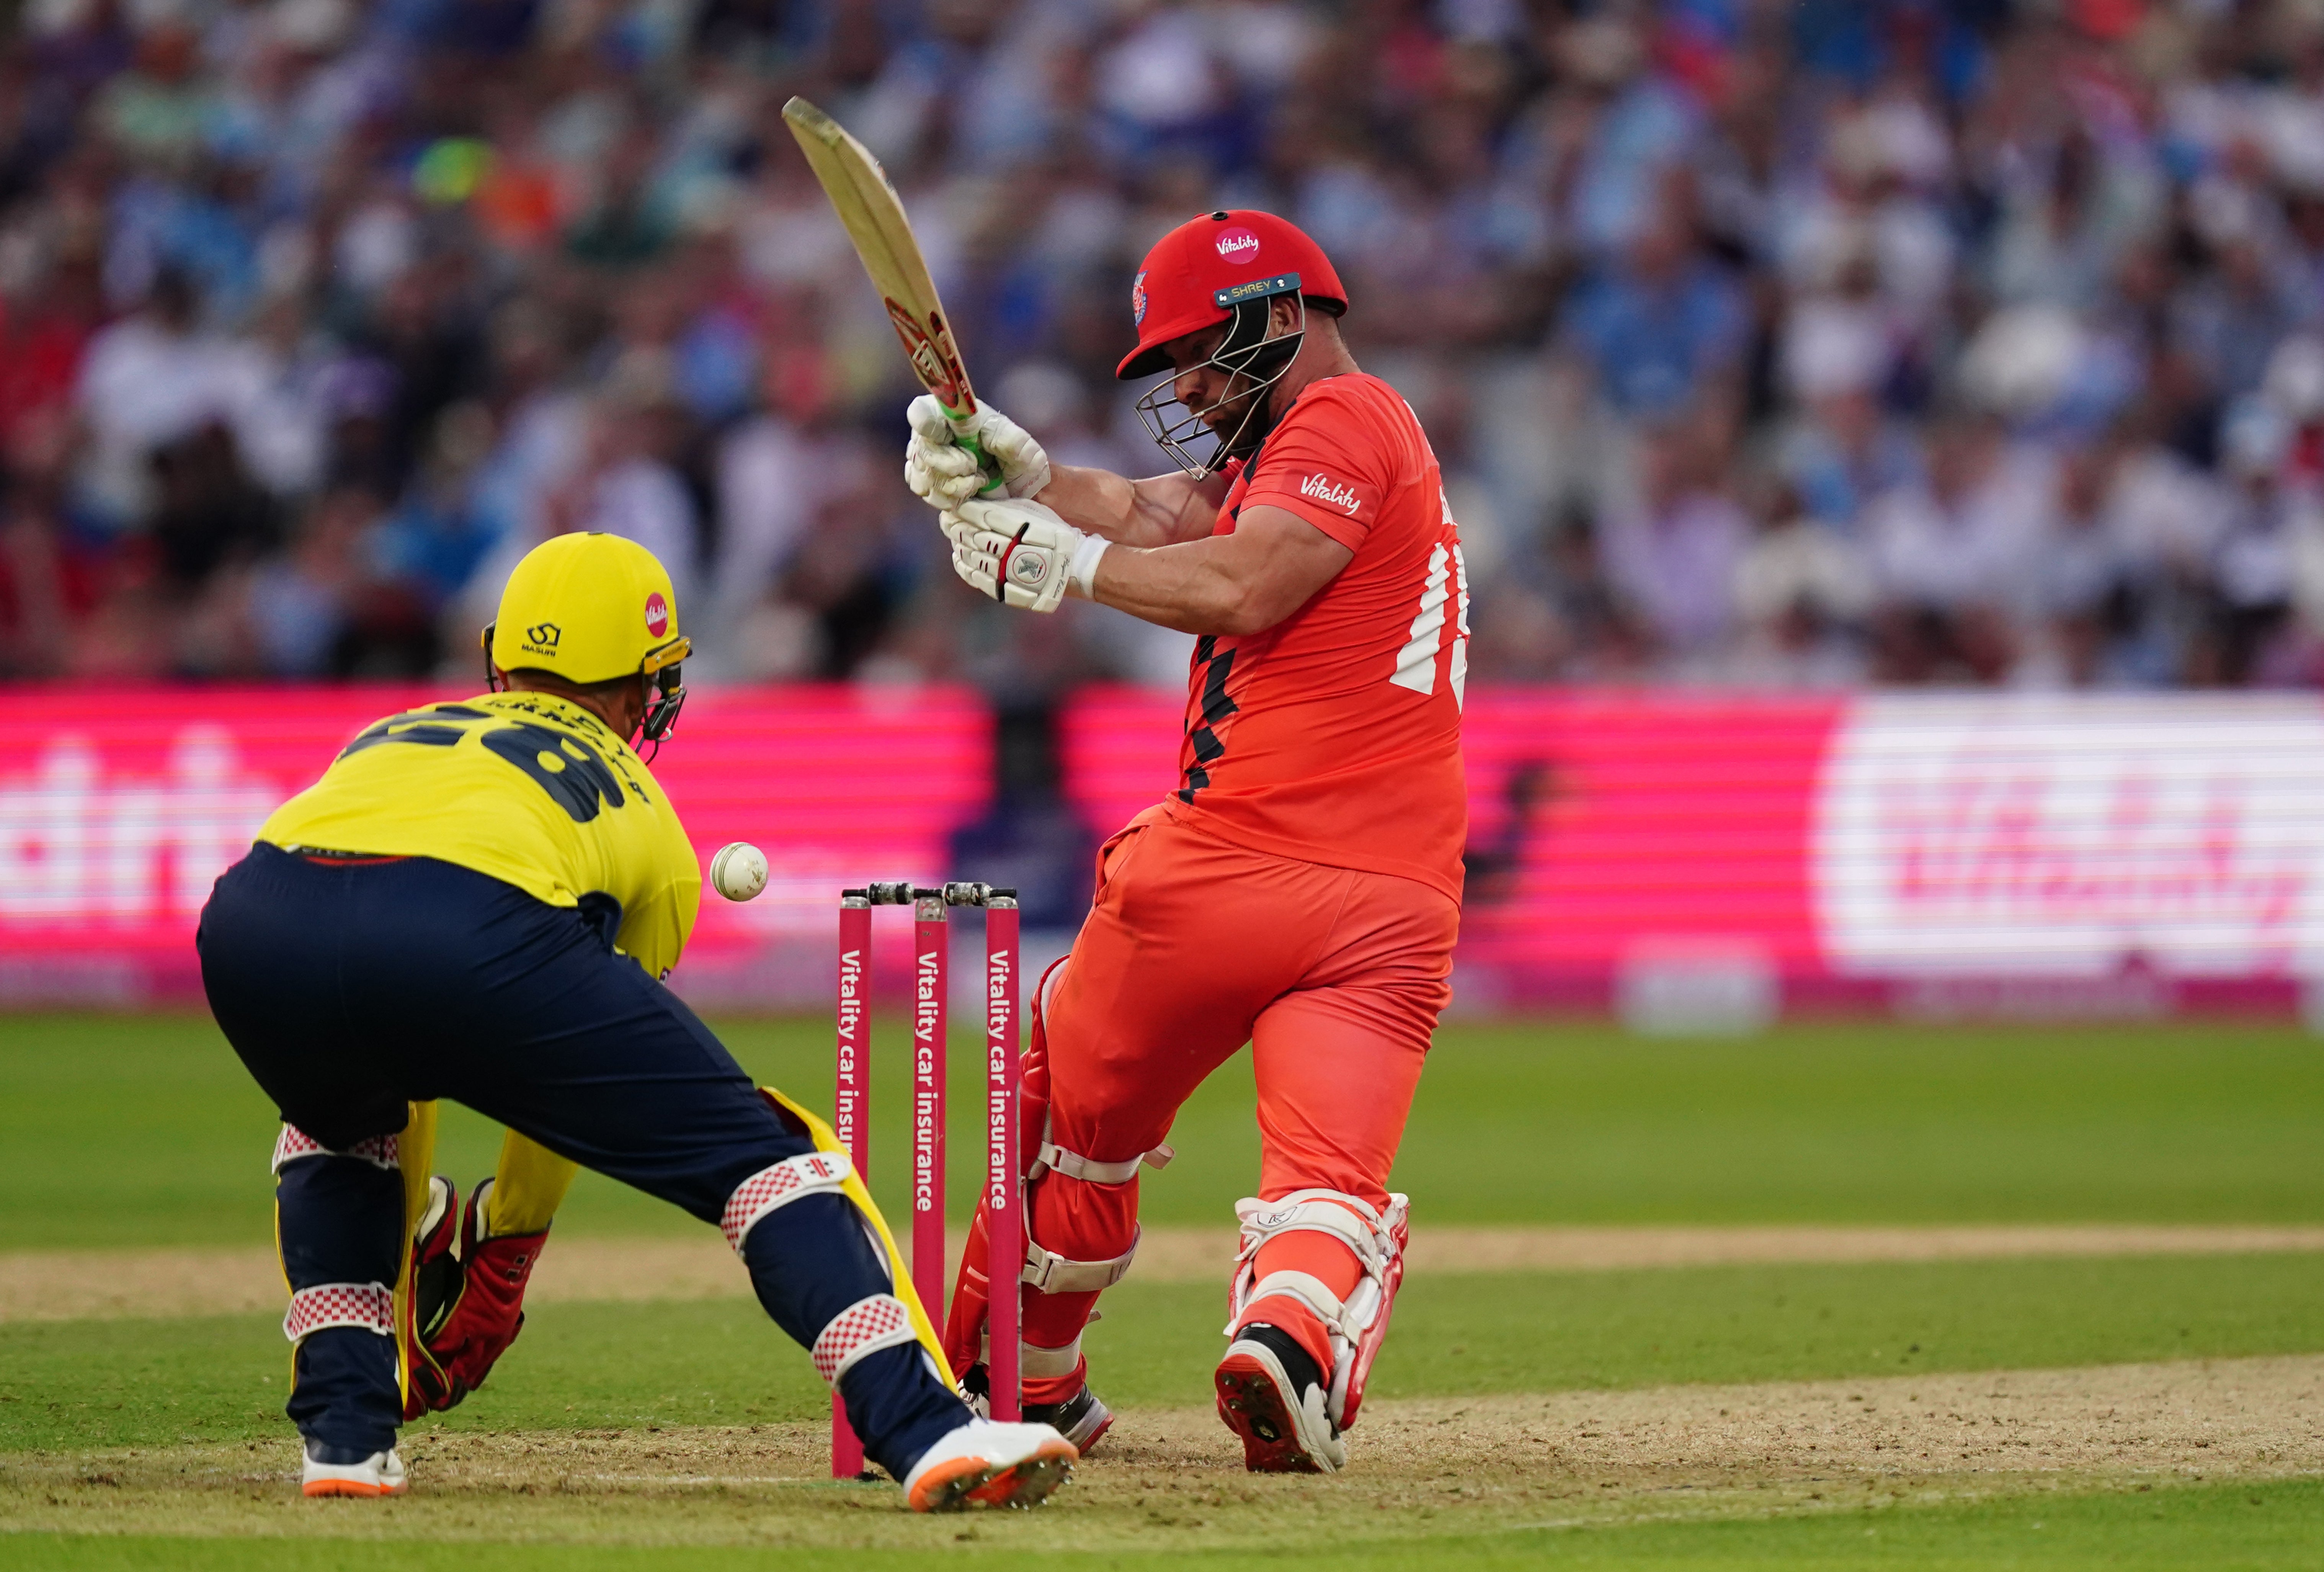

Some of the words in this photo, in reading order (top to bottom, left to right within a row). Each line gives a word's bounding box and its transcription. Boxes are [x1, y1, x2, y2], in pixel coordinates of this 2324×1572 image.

[1216, 235, 1259, 255] Vitality
[1231, 280, 1271, 298] SHREY
[1301, 473, 1361, 515] Vitality
[646, 603, 668, 626] Vitality
[521, 643, 556, 657] MASURI
[838, 950, 861, 1040] Vitality
[915, 951, 939, 1042] Vitality
[988, 950, 1010, 1041] Vitality
[839, 1045, 854, 1085] car
[918, 1047, 933, 1087] car
[990, 1046, 1005, 1085] car
[917, 1092, 938, 1211] insurance
[990, 1090, 1011, 1210] insurance
